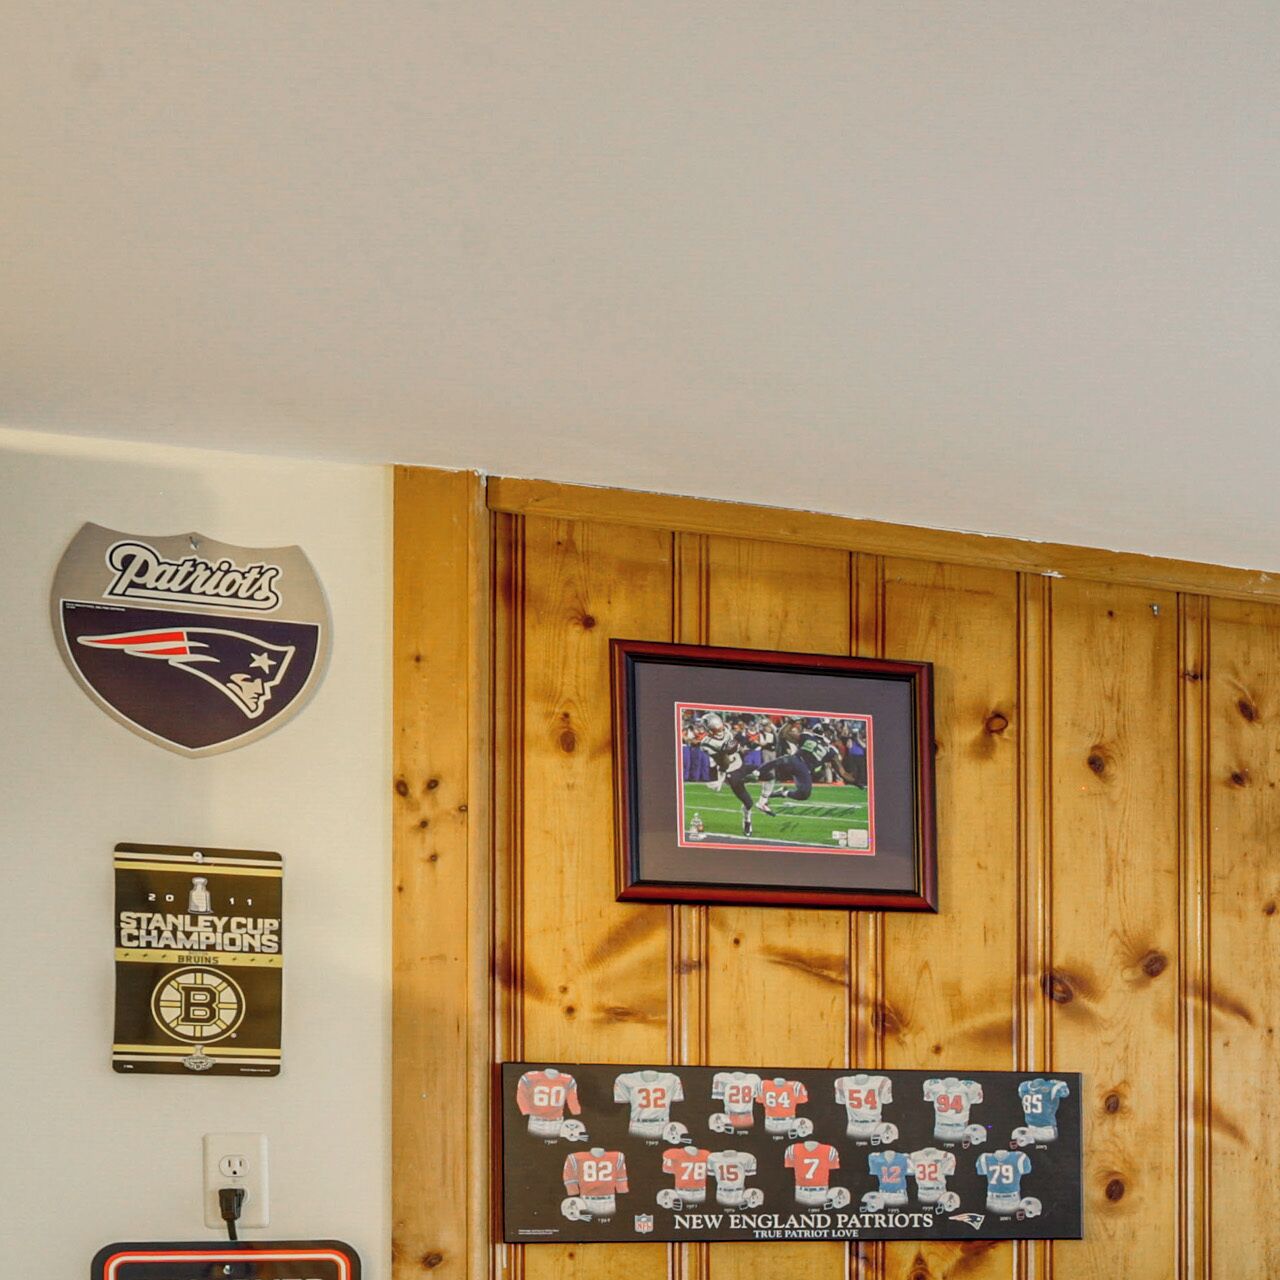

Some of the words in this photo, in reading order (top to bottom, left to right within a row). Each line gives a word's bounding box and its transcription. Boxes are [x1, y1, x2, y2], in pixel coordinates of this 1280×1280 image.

[105, 540, 284, 612] Patriots
[119, 911, 229, 933] STANLEY
[230, 917, 279, 935] CUP
[120, 928, 280, 953] CHAMPIONS
[177, 955, 219, 964] BRUINS
[533, 1086, 565, 1107] 60
[638, 1087, 666, 1109] 32
[728, 1085, 752, 1104] 28
[765, 1091, 791, 1109] 64
[848, 1089, 878, 1110] 54
[936, 1094, 964, 1114] 94
[1021, 1094, 1043, 1114] 85
[583, 1160, 613, 1182] 82
[681, 1161, 706, 1181] 78
[718, 1164, 739, 1182] 15
[803, 1158, 820, 1180] 7
[881, 1166, 900, 1183] 12
[916, 1164, 938, 1181] 32
[988, 1164, 1014, 1184] 79
[674, 1214, 724, 1229] NEW
[729, 1213, 831, 1229] ENGLAND
[836, 1213, 934, 1228] PATRIOTS
[754, 1229, 783, 1238] TRUE
[784, 1229, 829, 1238] PATRIOT
[831, 1229, 859, 1238] LOVE
